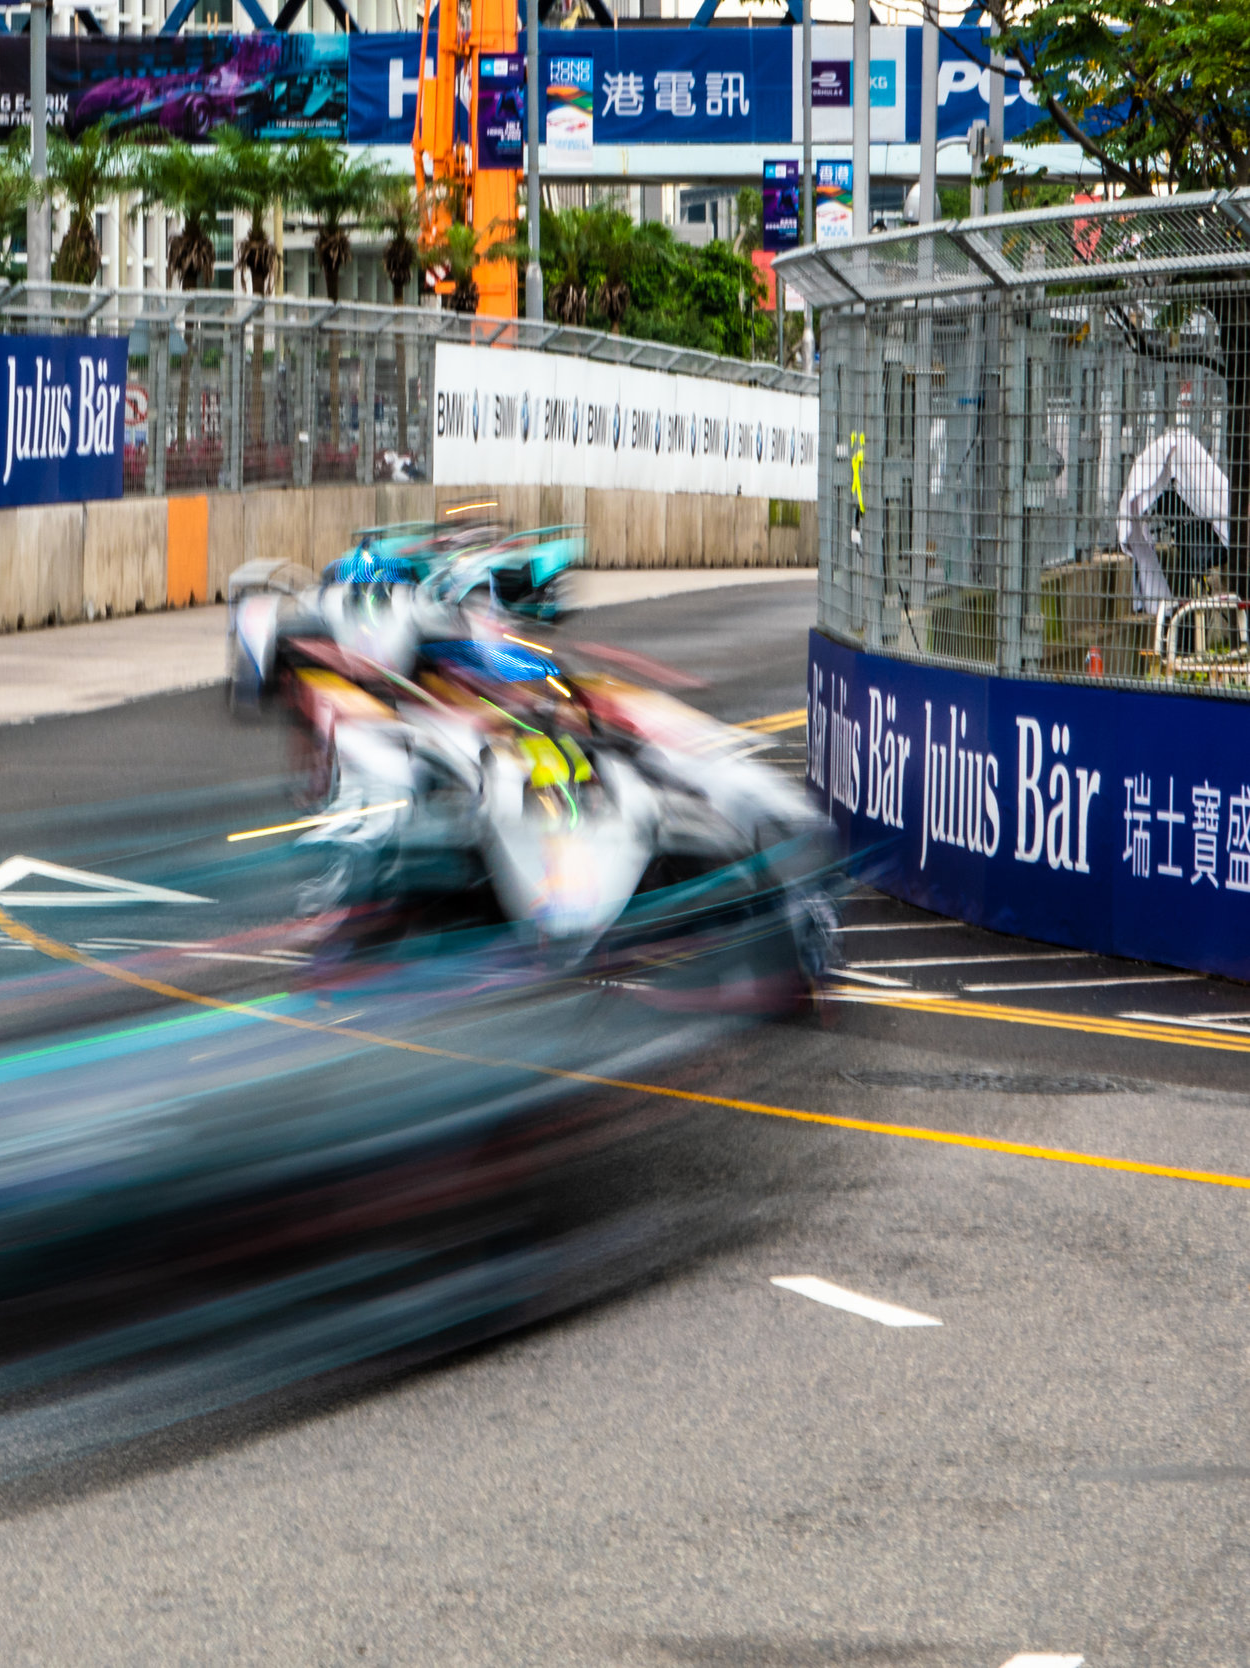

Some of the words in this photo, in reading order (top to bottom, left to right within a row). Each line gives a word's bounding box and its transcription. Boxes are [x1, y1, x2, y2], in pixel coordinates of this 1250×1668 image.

[870, 76, 888, 89] KG
[3, 356, 71, 485] Julius
[76, 356, 120, 455] Bär
[438, 392, 465, 437] BMW
[829, 672, 861, 826] Julius
[866, 686, 911, 830] Bär
[920, 700, 1000, 870] Julius
[1014, 716, 1101, 874] Bär
[1122, 771, 1250, 892] 瑞士寶盛
